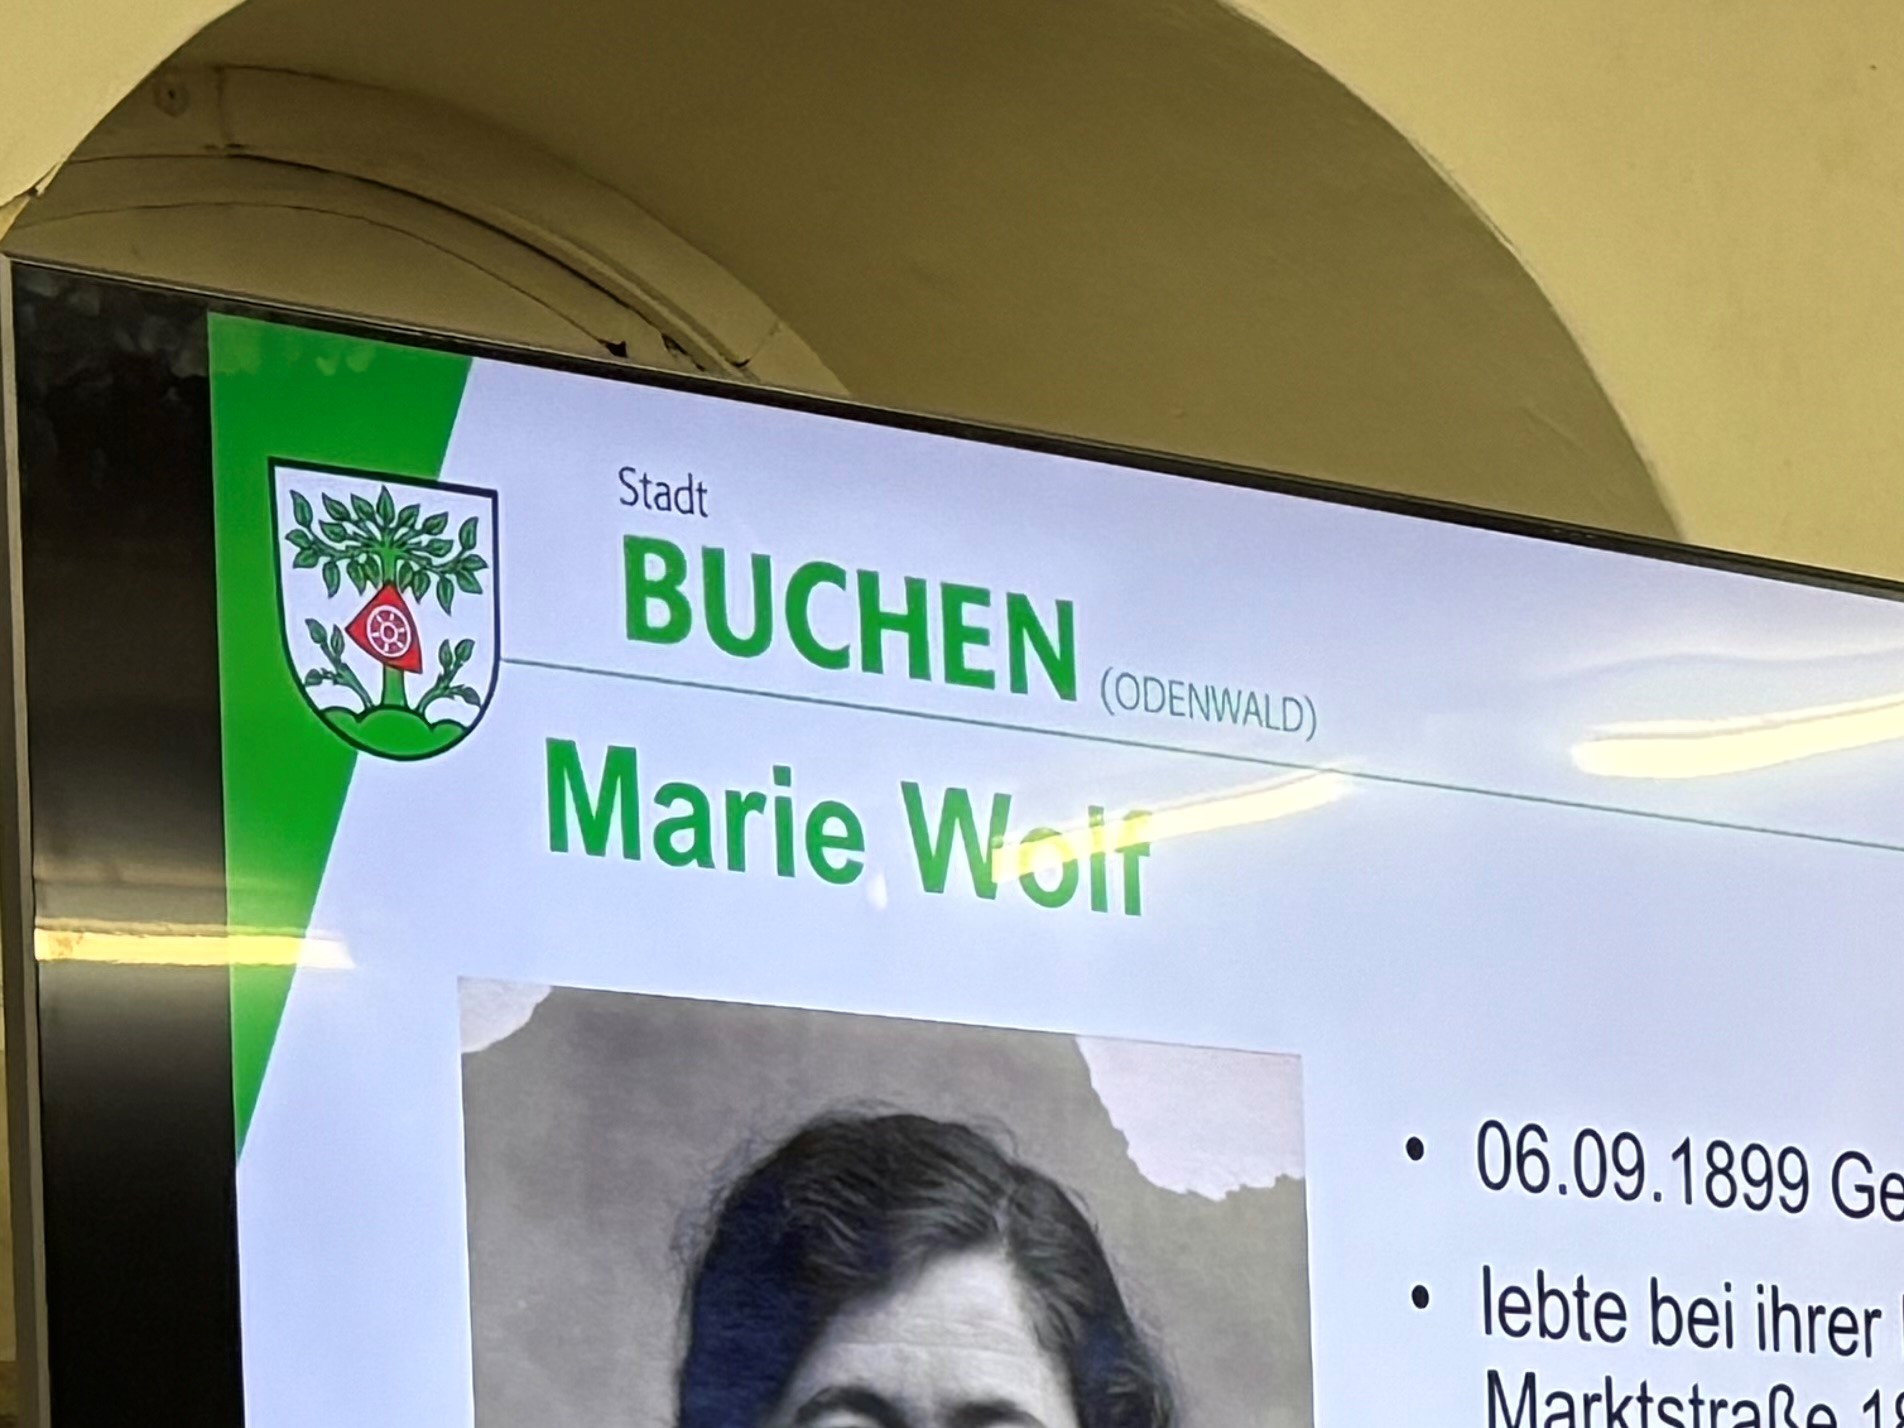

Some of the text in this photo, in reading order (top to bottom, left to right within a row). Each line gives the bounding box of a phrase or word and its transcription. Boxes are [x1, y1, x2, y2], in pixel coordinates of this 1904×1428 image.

[619, 466, 708, 518] Stadt
[624, 535, 1317, 742] BUCHEN (ODENWALD)
[546, 738, 1151, 916] Marie Wolf
[1478, 1120, 1809, 1213] 06.09.1899
[1483, 1265, 1626, 1343] lebte
[1651, 1277, 1733, 1349] bei
[1757, 1284, 1882, 1358] ihrer
